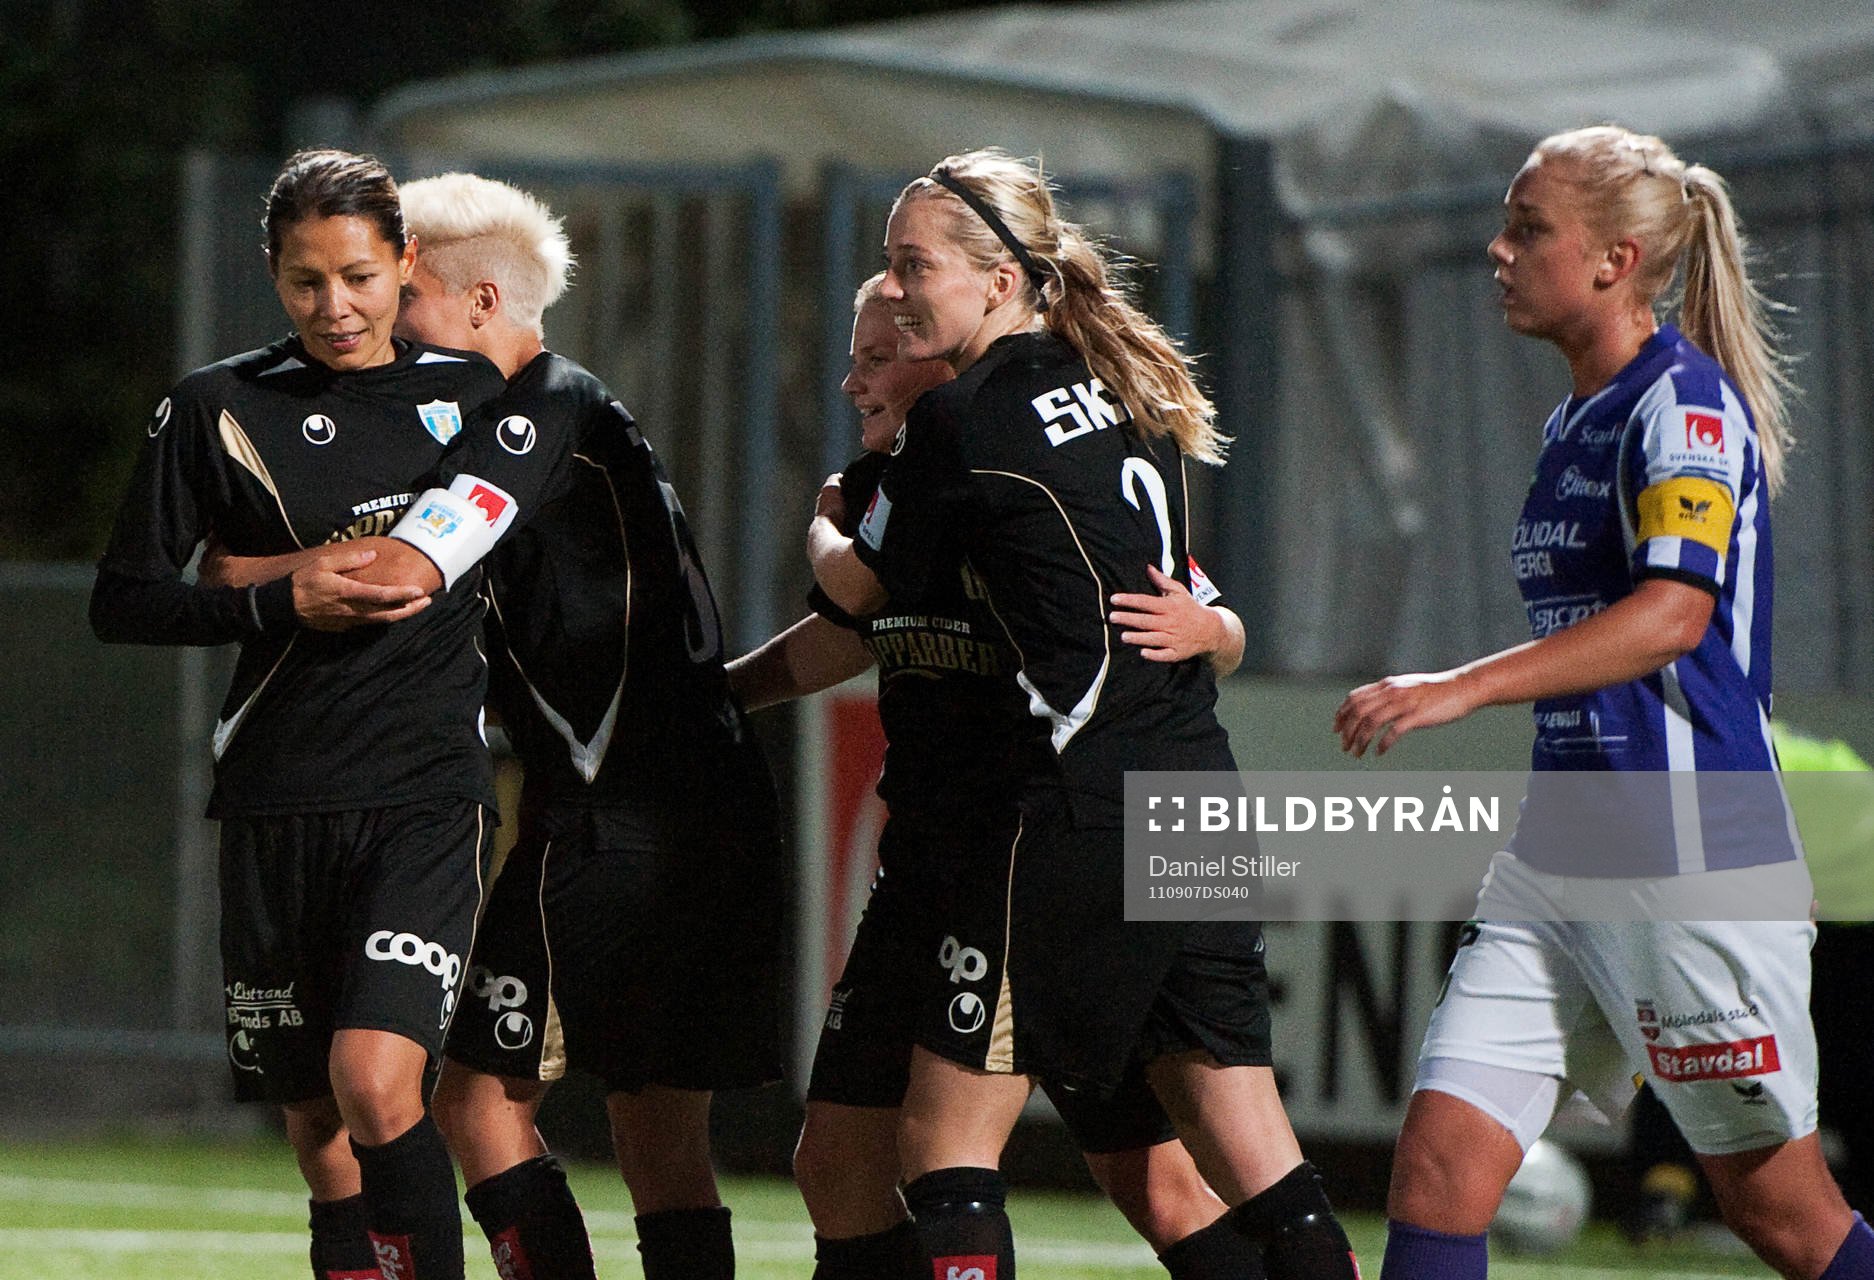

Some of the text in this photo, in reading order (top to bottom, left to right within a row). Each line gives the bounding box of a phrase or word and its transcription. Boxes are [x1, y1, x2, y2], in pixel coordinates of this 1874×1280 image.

[1030, 378, 1134, 448] SK
[872, 616, 971, 635] PREMIUM CIDER
[365, 930, 461, 990] coop
[278, 1010, 304, 1026] AB
[1656, 1044, 1764, 1076] Stavdal
